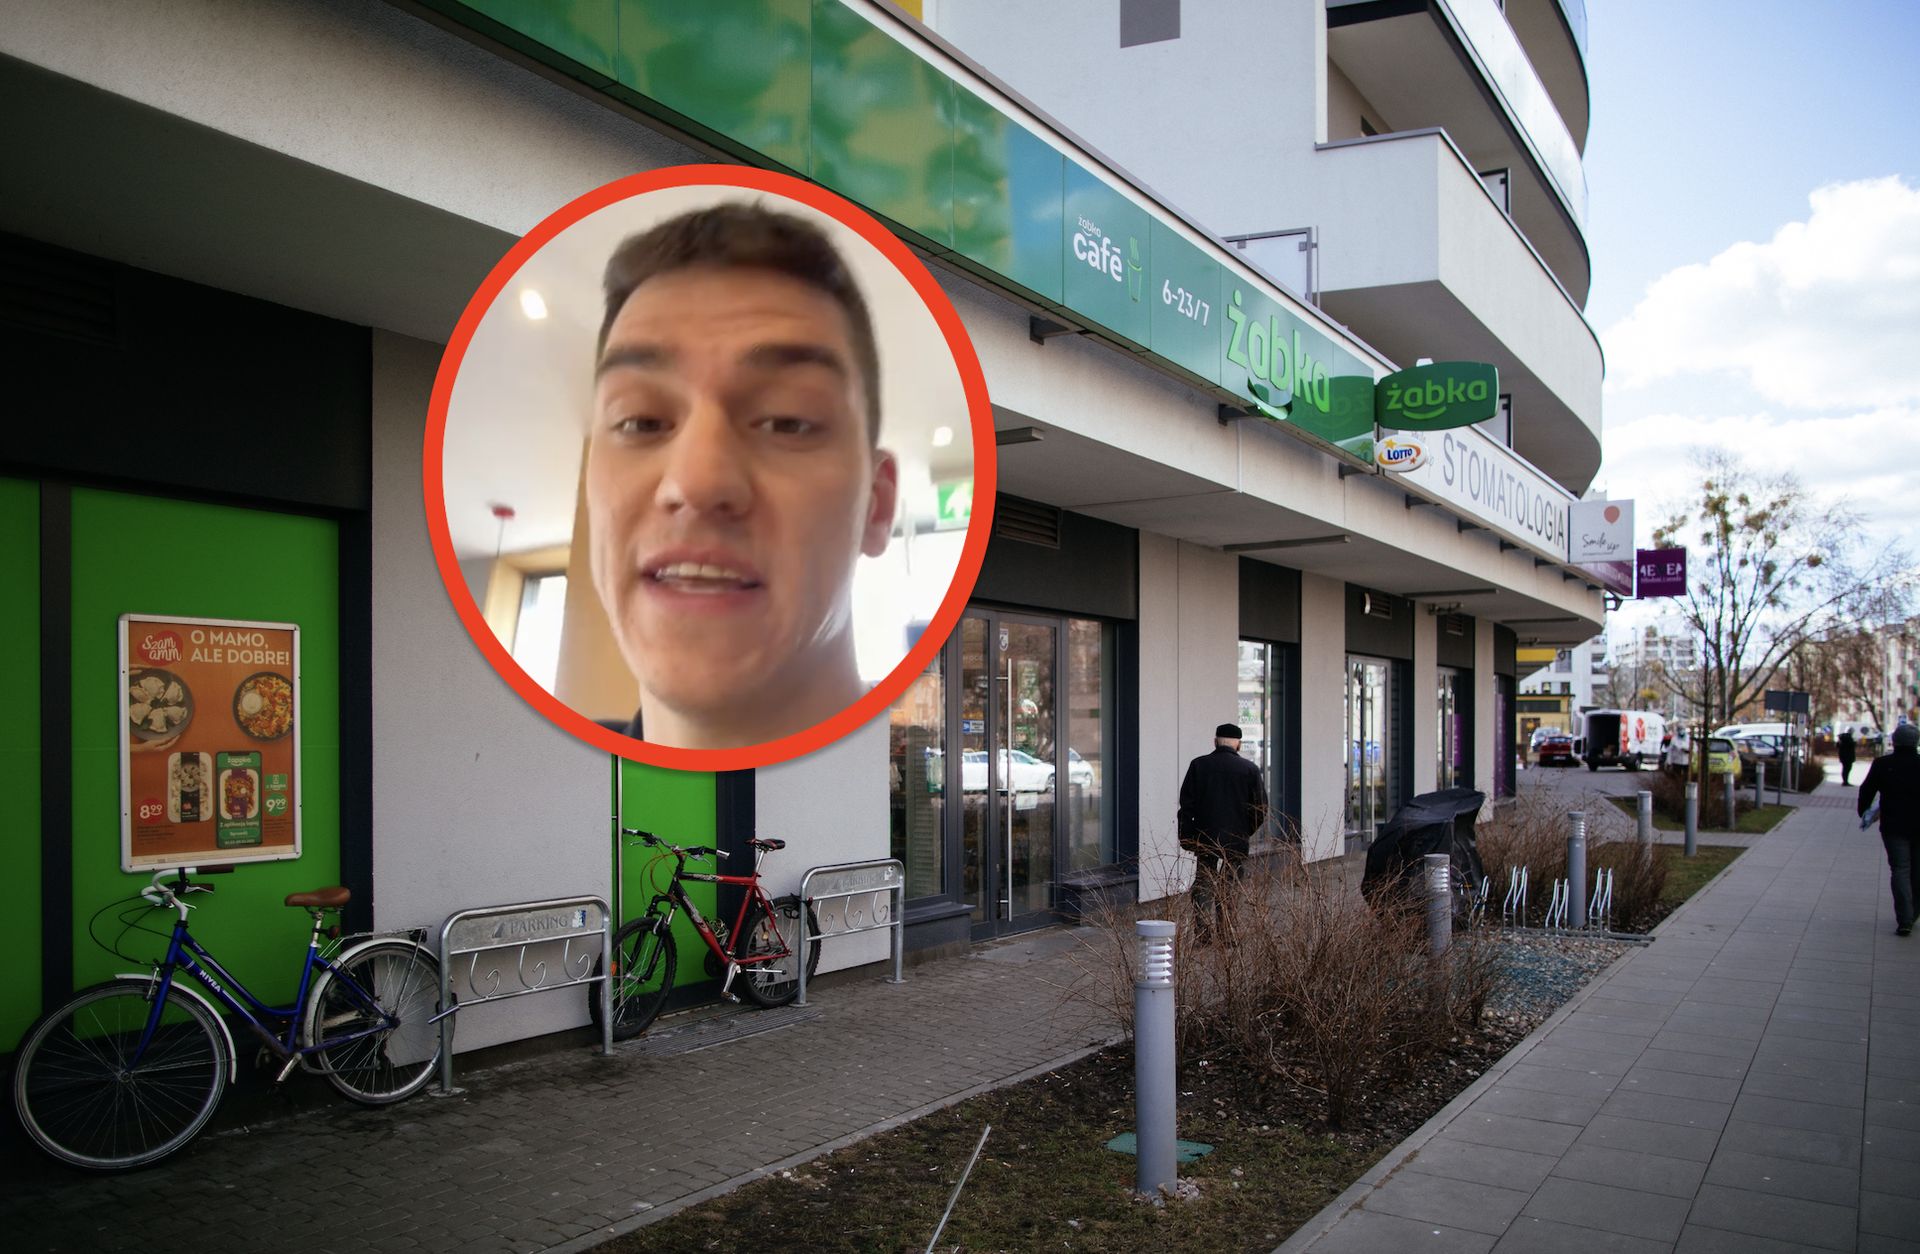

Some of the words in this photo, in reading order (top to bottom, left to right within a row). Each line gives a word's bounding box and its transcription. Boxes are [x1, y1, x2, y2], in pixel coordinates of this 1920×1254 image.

[1162, 279, 1210, 327] 6-23/7
[1226, 289, 1330, 413] żabka
[1386, 377, 1488, 411] żabka
[1387, 448, 1413, 461] LOTTO
[1443, 432, 1565, 551] STOMATOLOGIA
[1582, 532, 1606, 548] Smile
[142, 634, 177, 650] Szam
[190, 629, 205, 645] O
[209, 631, 269, 649] MAMO,
[148, 648, 182, 662] amm
[190, 648, 223, 663] ALE
[227, 649, 290, 665] DOBRE!
[510, 916, 568, 934] PARKING
[199, 969, 221, 993] NIVEA
